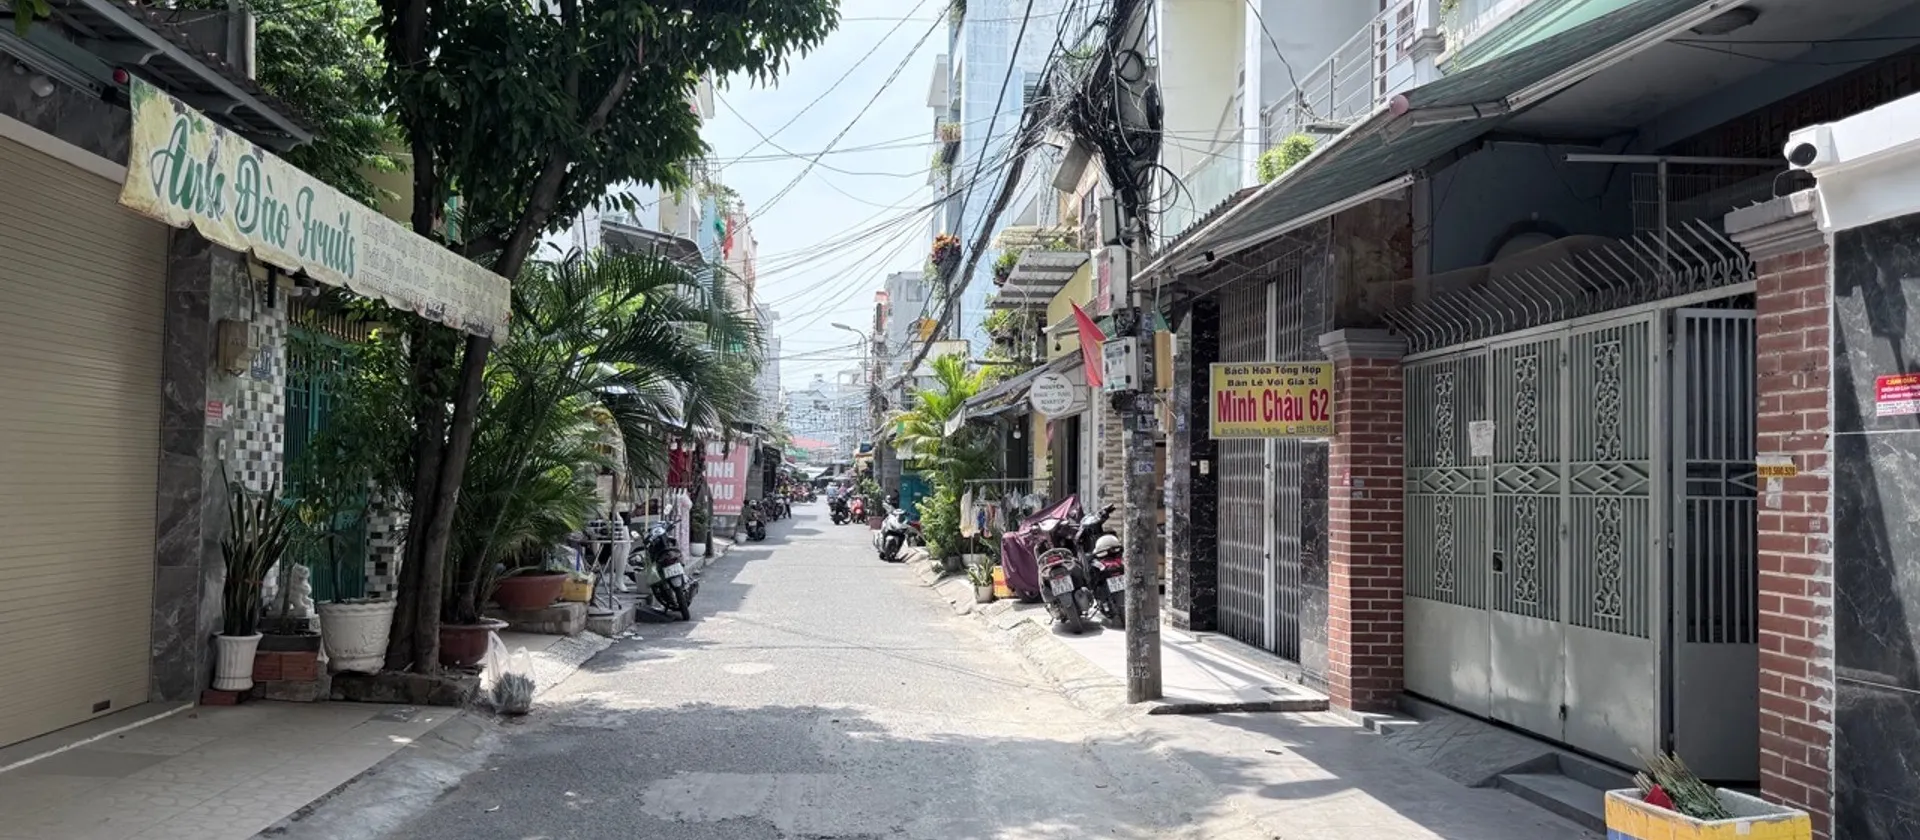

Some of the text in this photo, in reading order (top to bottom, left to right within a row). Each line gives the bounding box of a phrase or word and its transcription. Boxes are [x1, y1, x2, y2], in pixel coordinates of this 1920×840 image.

[151, 117, 226, 222] Anh
[235, 154, 290, 249] Đào
[296, 186, 355, 279] Fruits
[1217, 388, 1329, 422] Minh Châu 62
